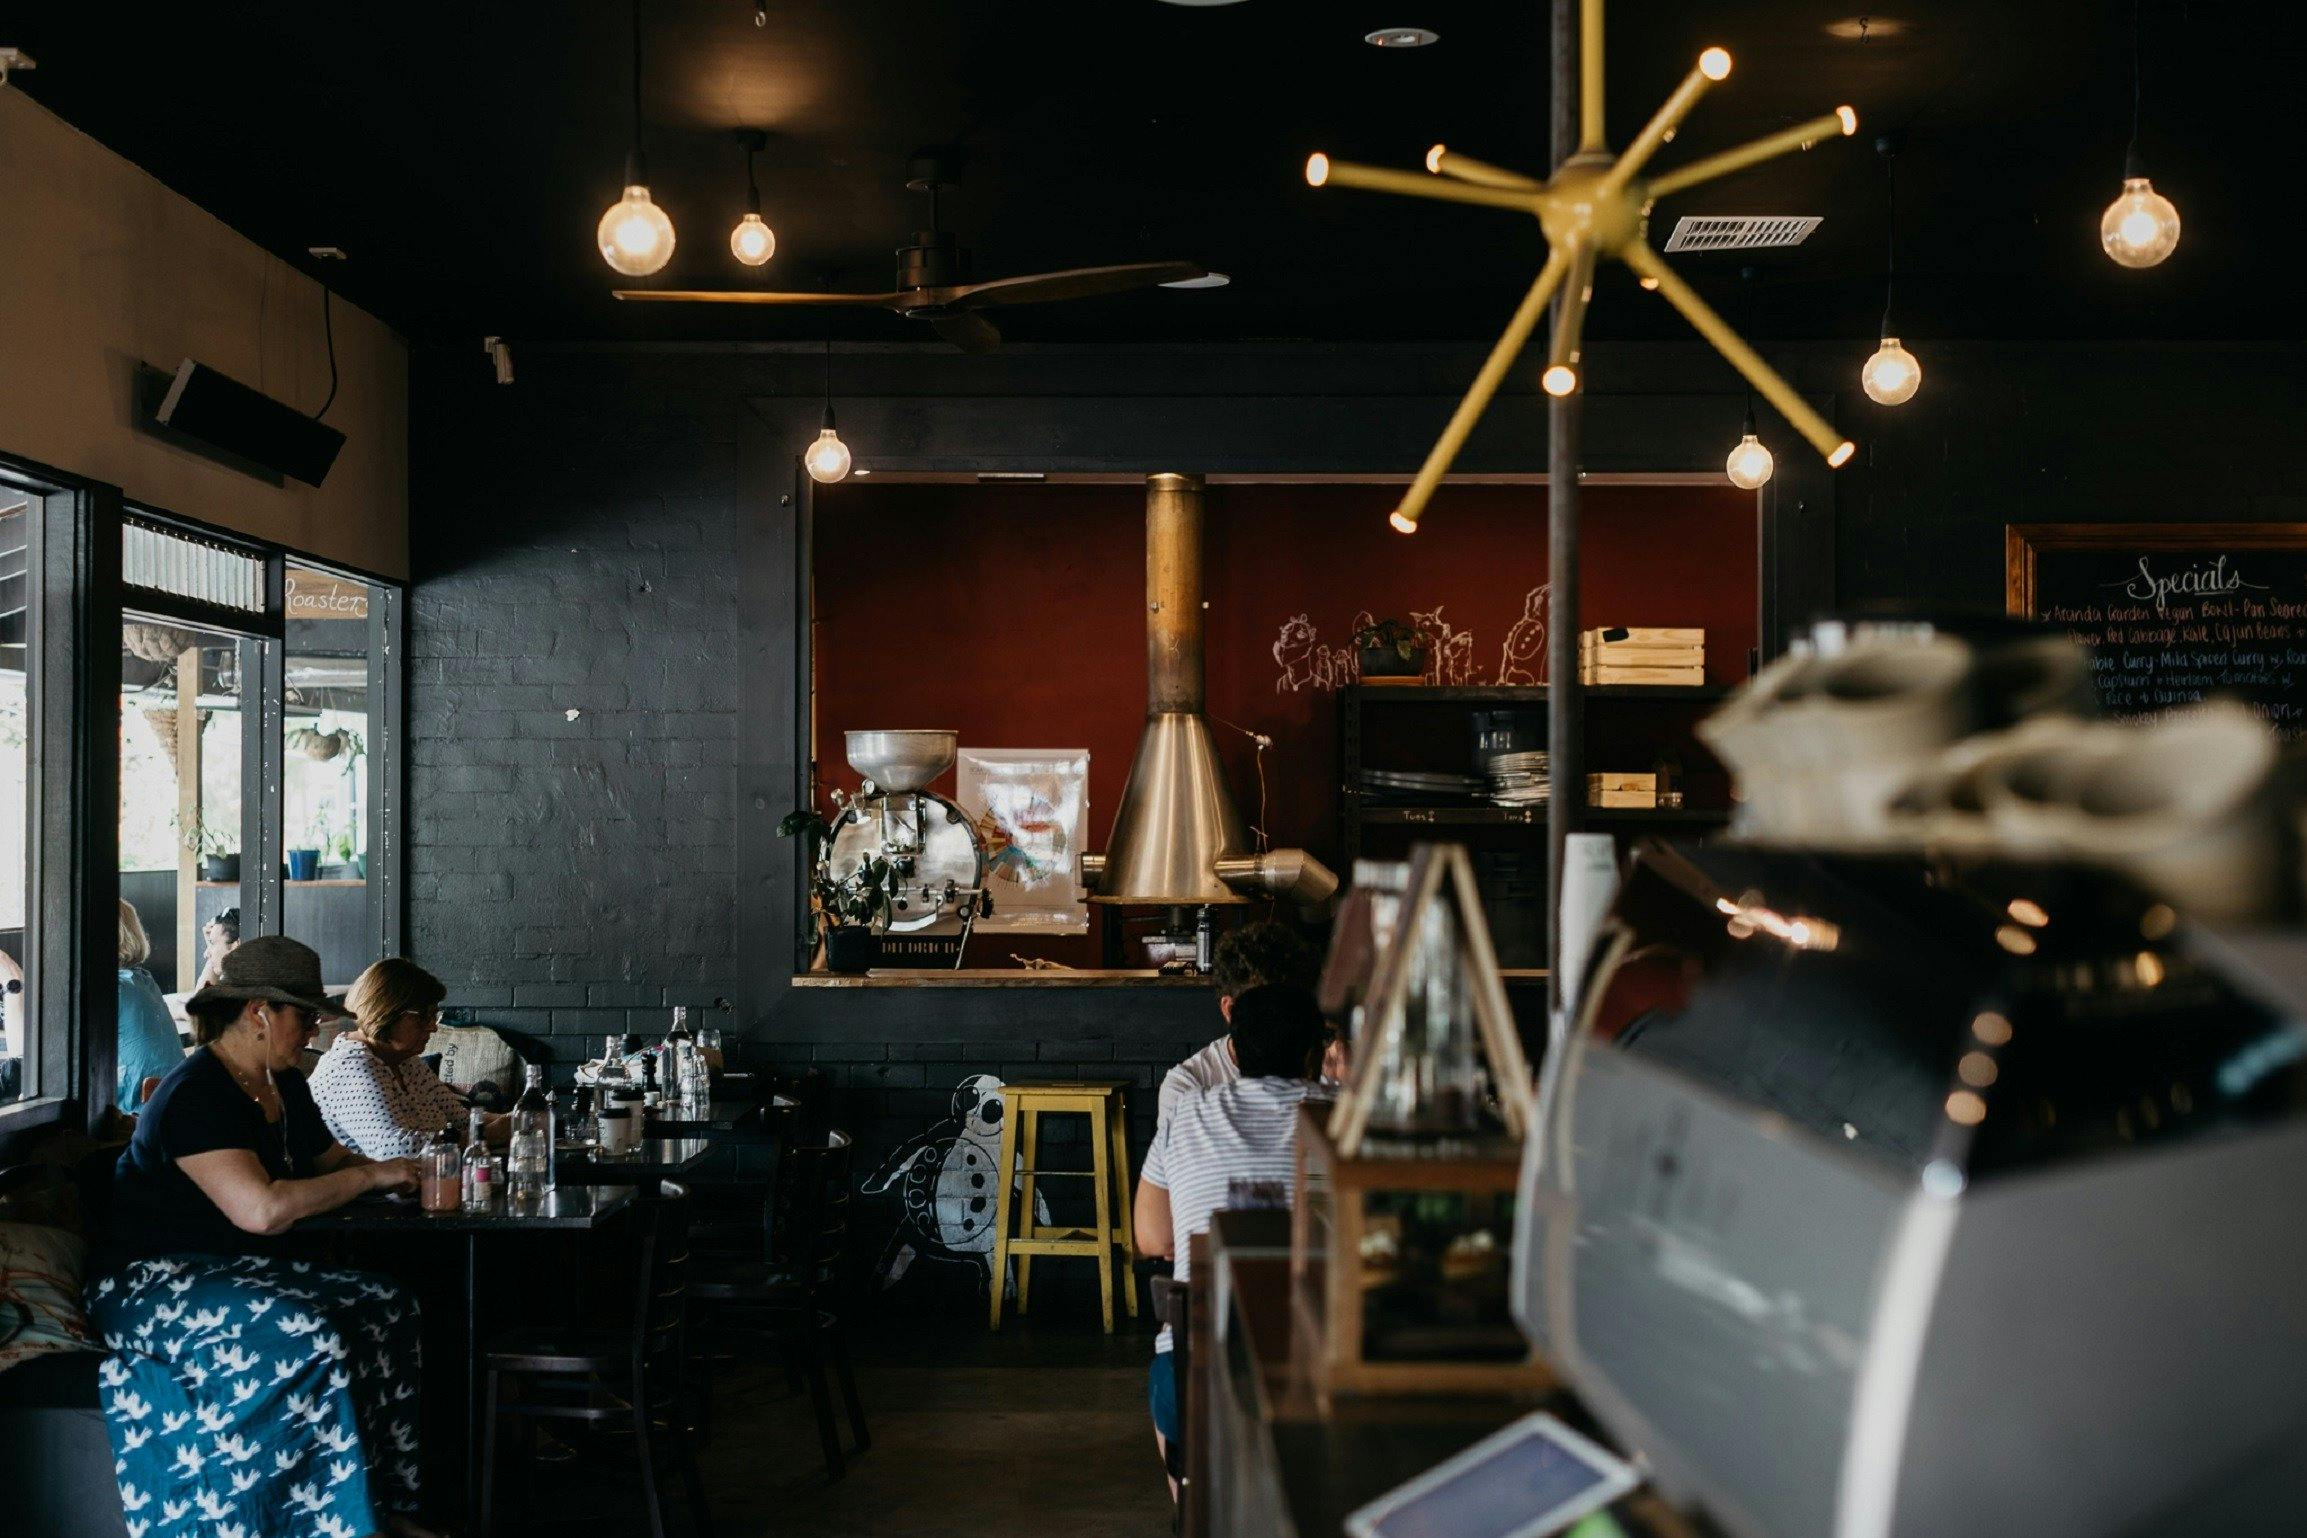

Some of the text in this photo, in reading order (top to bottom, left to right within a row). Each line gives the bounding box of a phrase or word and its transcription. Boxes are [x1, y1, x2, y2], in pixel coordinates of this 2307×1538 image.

[2116, 554, 2252, 612] Specials
[2107, 603, 2150, 621] Garden
[446, 1042, 459, 1057] by
